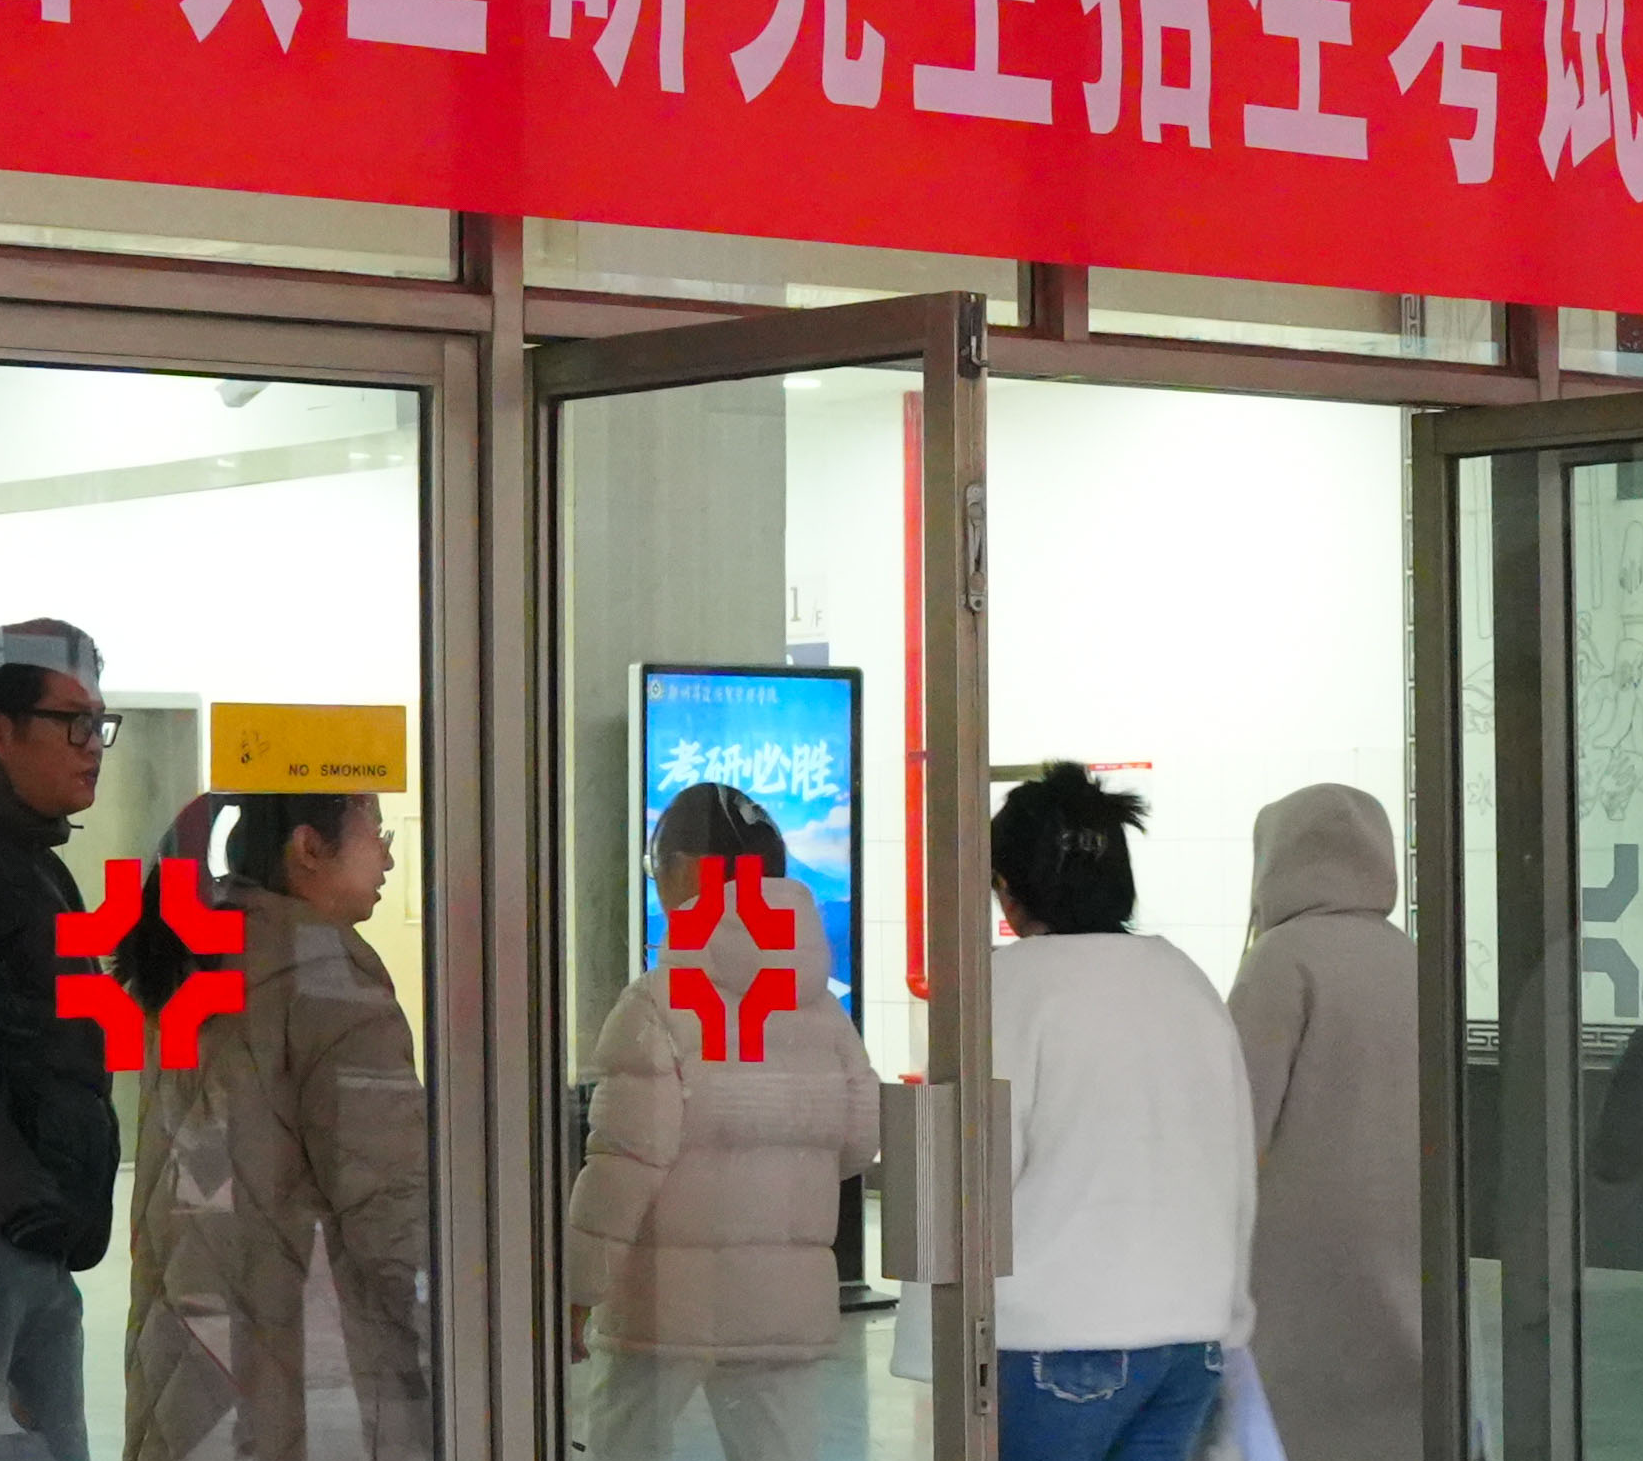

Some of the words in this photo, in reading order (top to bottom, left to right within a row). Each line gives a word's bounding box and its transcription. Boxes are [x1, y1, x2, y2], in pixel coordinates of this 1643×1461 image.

[288, 764, 310, 777] NO
[320, 763, 388, 777] SMOKING
[657, 738, 840, 802] 考研必胜
